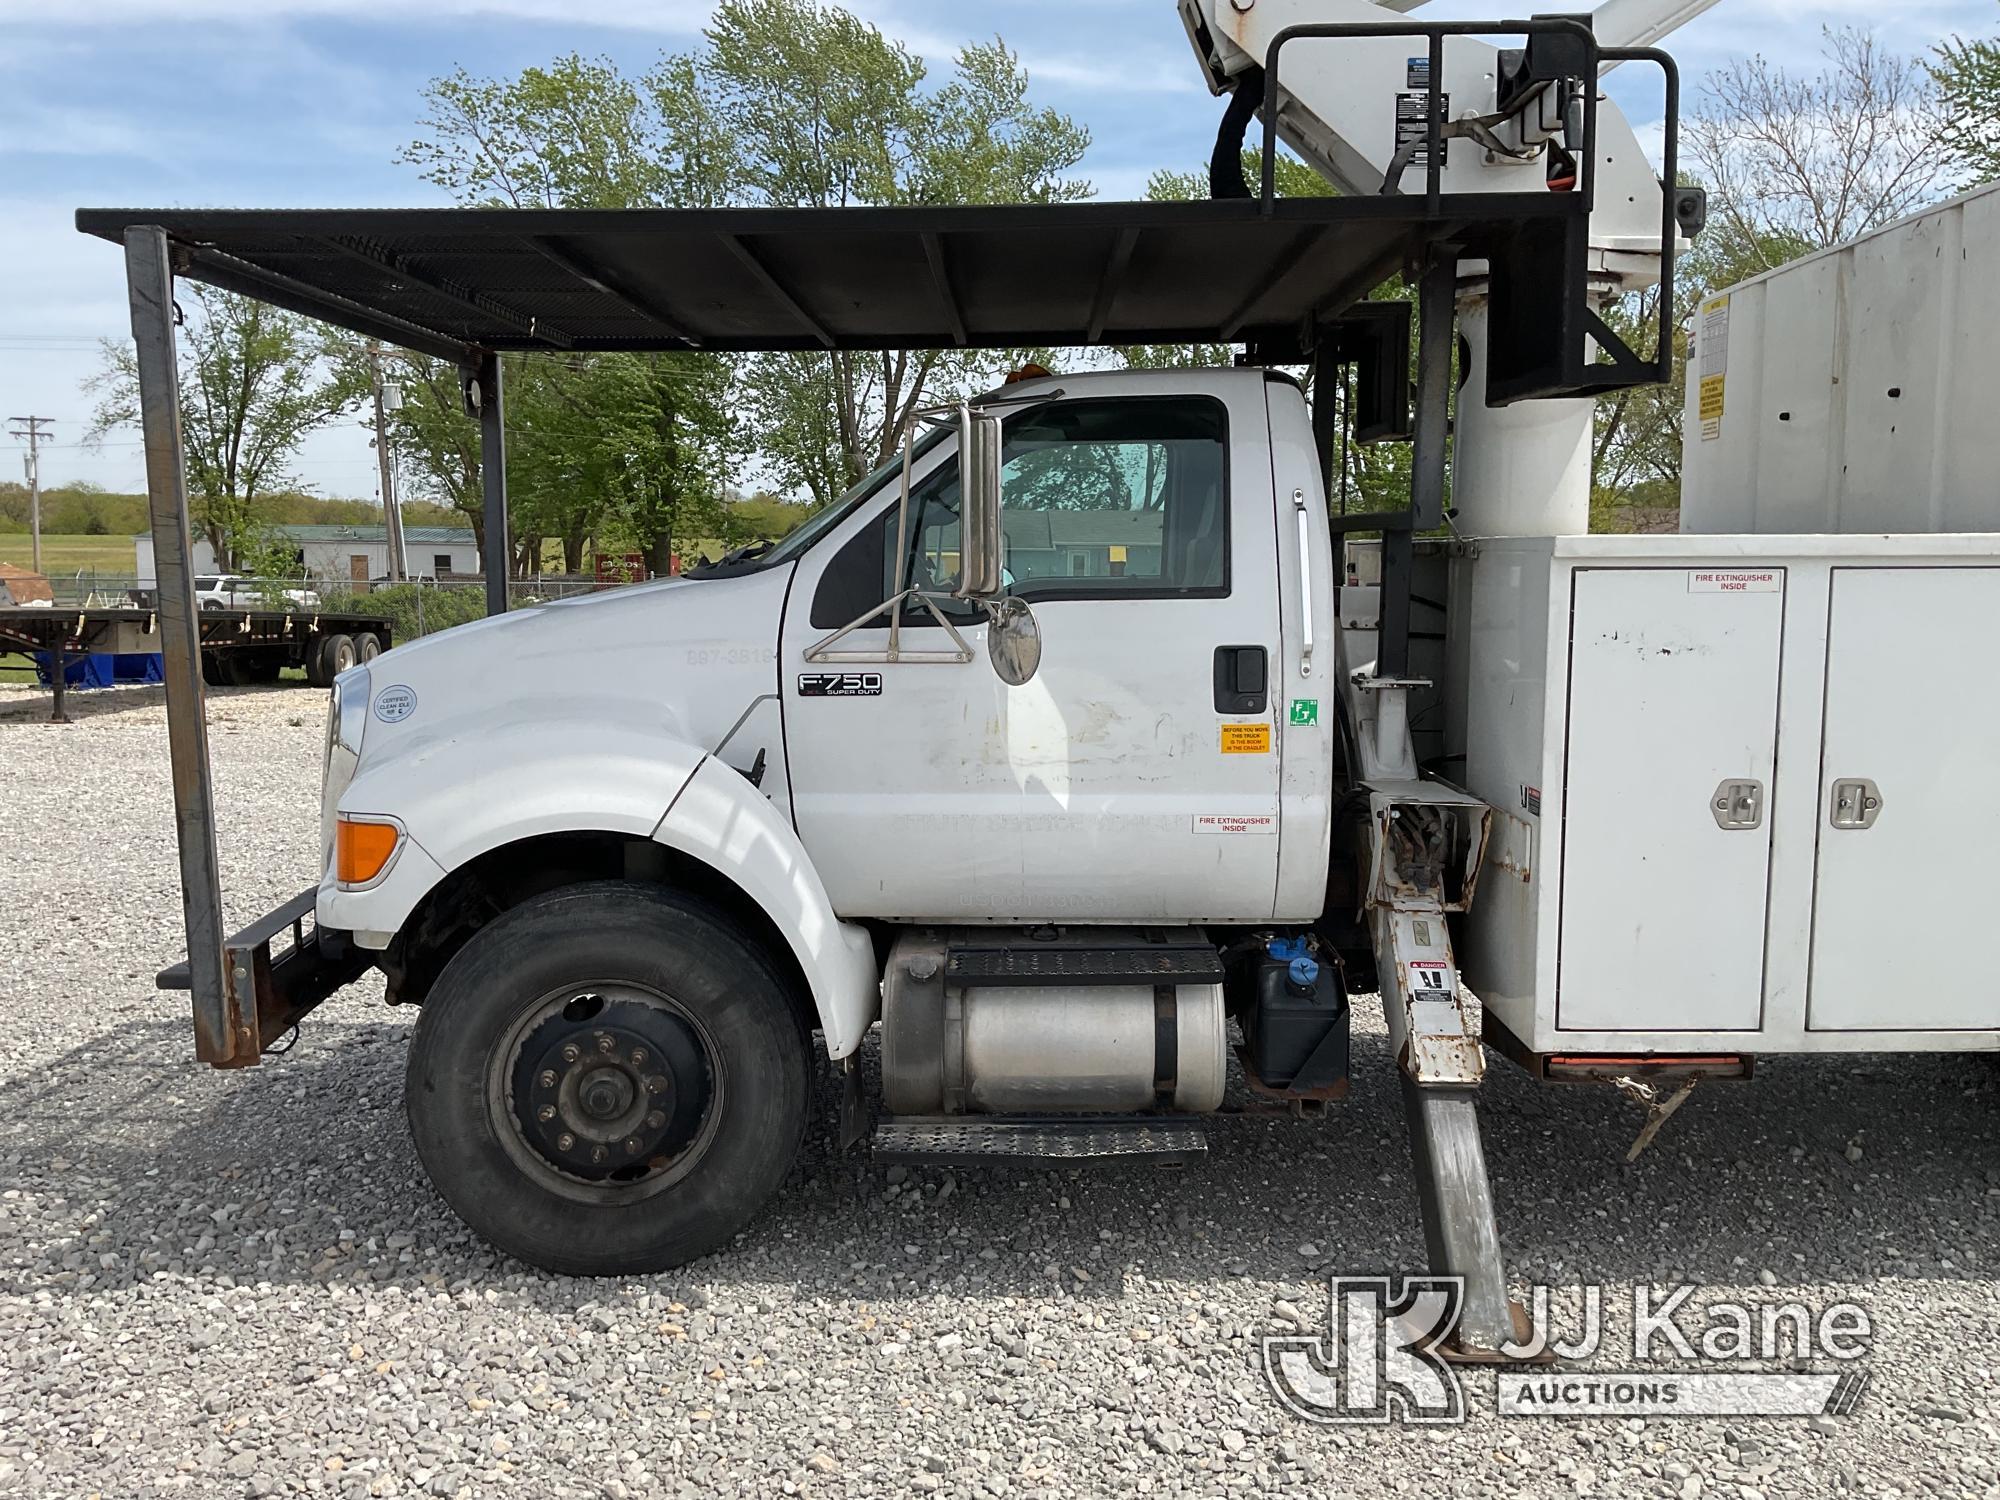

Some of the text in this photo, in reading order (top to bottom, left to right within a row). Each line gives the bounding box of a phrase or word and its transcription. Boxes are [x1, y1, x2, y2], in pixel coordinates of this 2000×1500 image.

[1695, 574, 1773, 582] FIRE EXTINGUISHER
[1720, 582, 1747, 590] INSIDE
